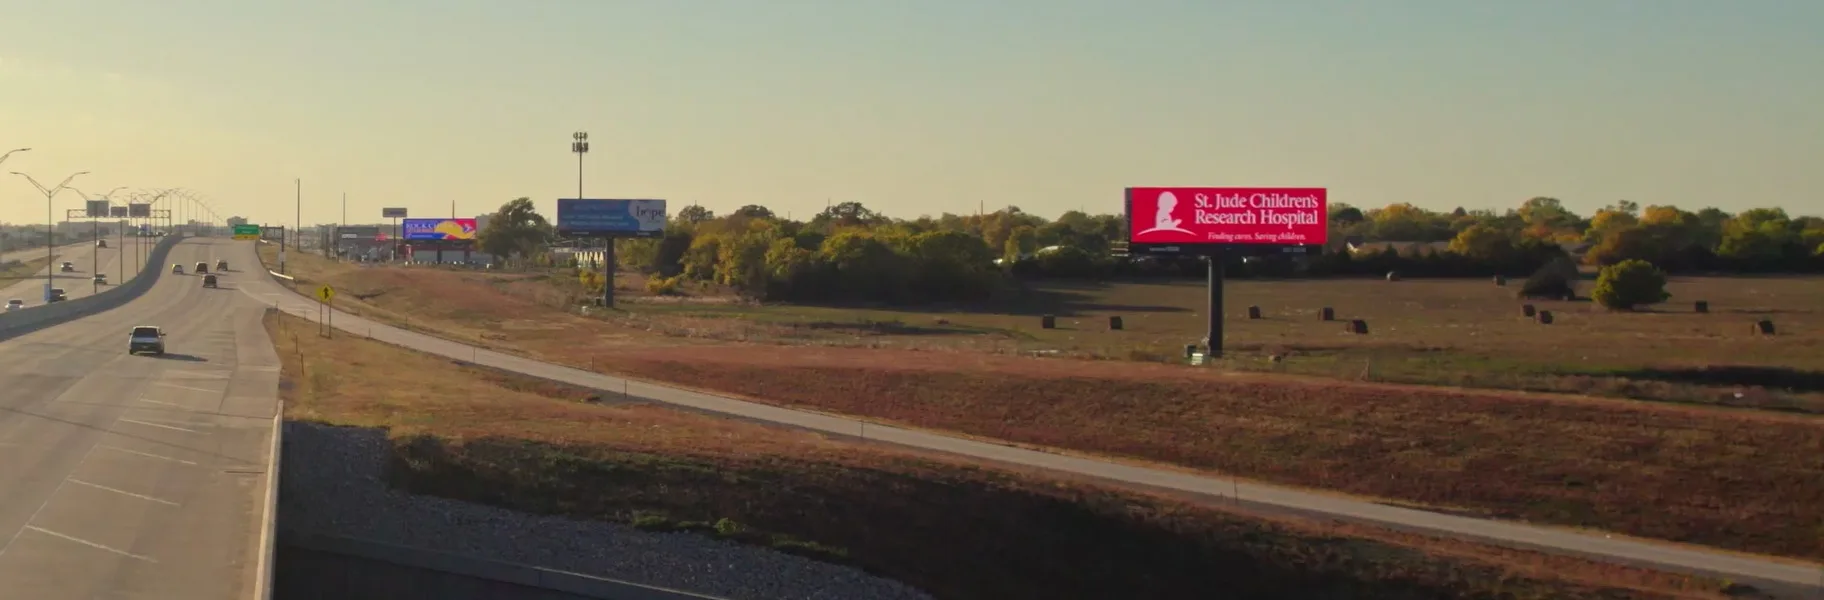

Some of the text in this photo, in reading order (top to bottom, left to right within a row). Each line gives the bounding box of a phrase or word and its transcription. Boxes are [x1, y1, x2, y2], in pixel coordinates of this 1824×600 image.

[1194, 193, 1318, 210] St. Jude Children's
[1194, 209, 1318, 229] Research Hospital
[1208, 232, 1234, 242] Finding
